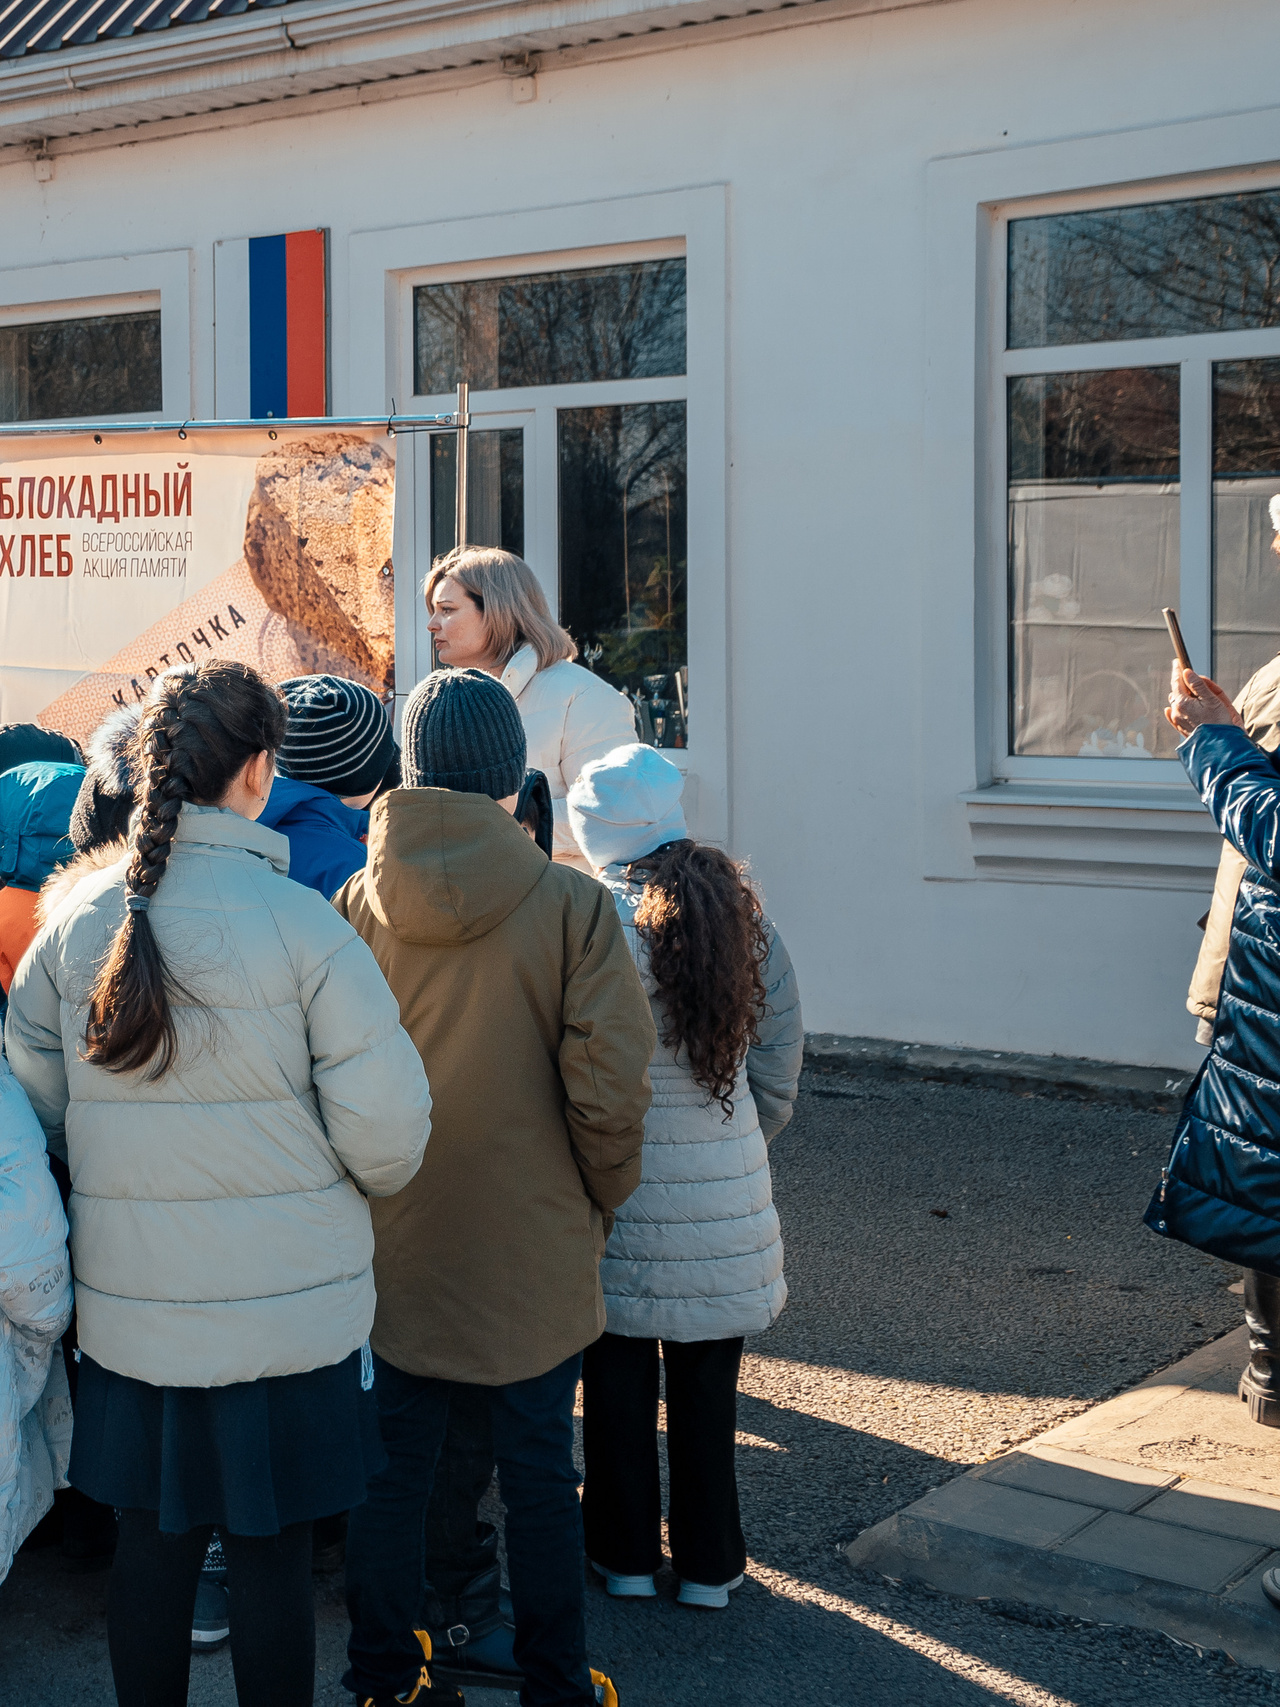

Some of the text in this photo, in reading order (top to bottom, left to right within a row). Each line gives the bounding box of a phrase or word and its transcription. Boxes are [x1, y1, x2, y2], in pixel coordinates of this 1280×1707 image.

[82, 528, 193, 553] ВСЕРОССИЙСКАЯ
[83, 557, 187, 579] АКЦИЯ ПАМЯТИ
